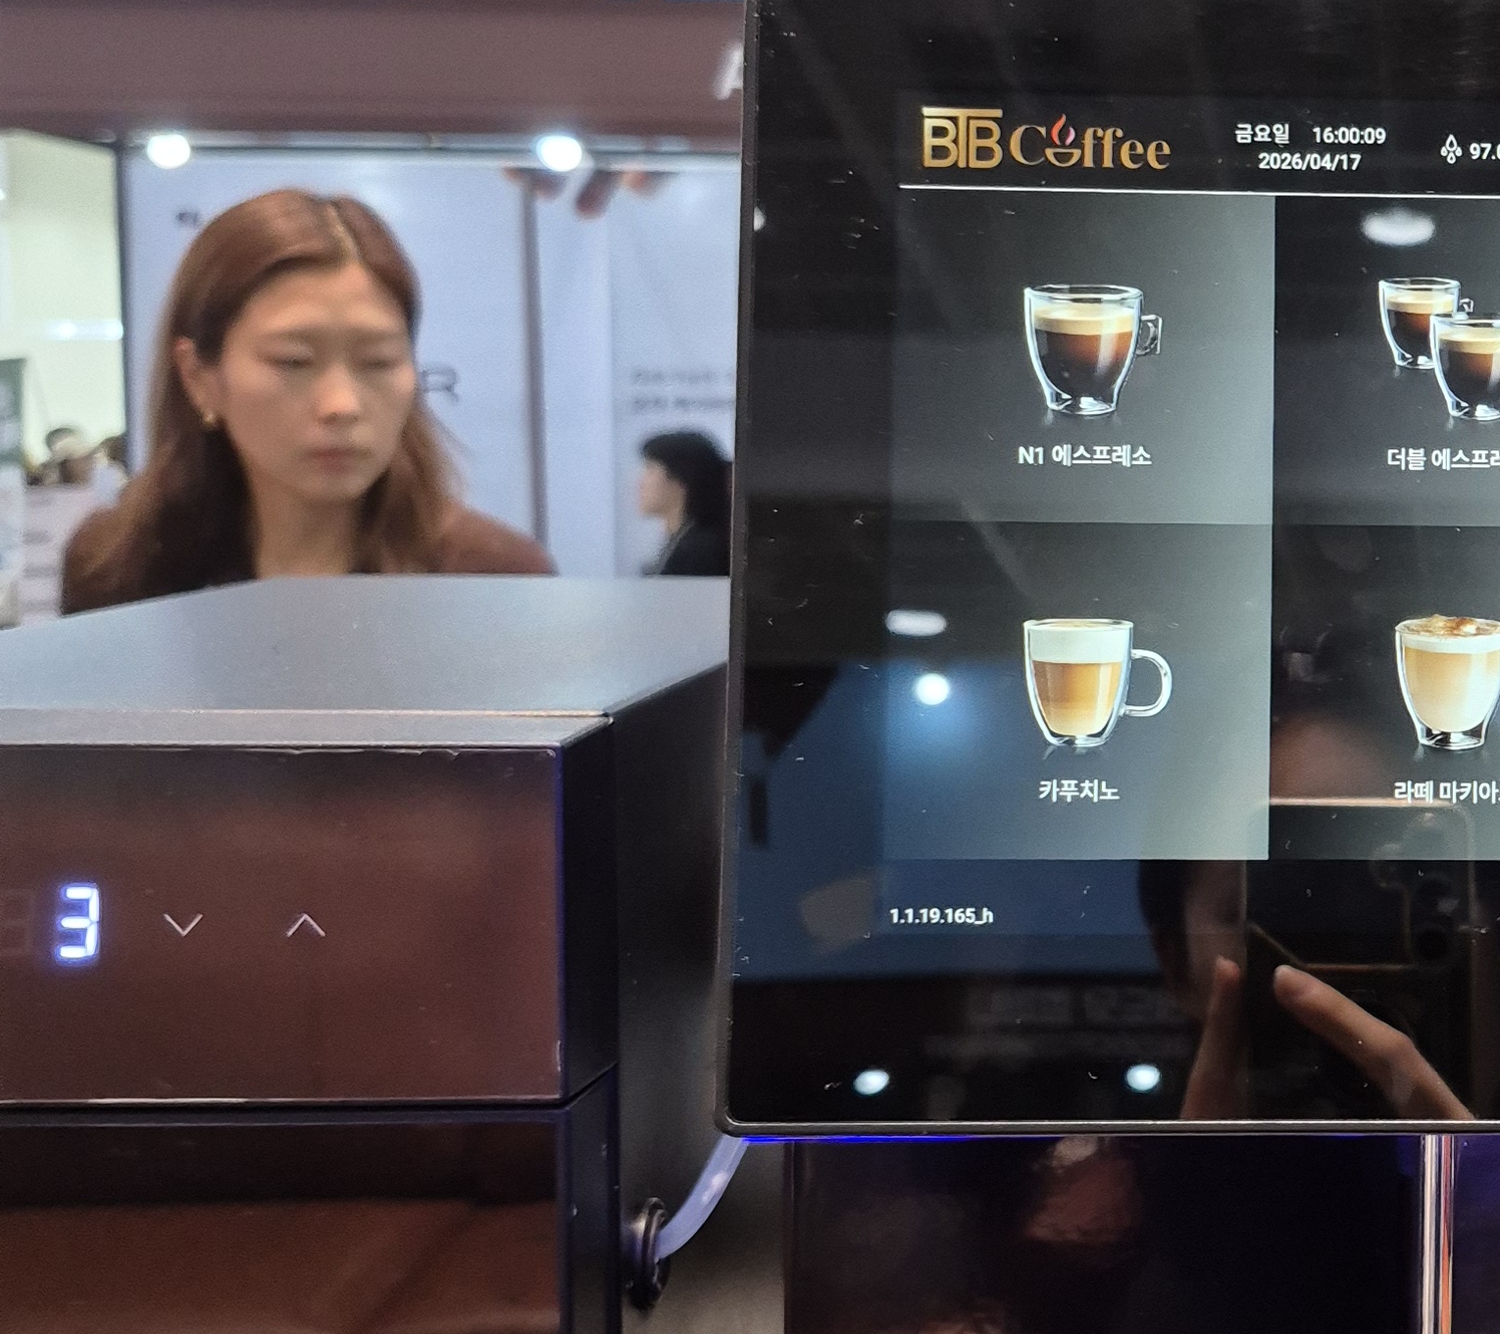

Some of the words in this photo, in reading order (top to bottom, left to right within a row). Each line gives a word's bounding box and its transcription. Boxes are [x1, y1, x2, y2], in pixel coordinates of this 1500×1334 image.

[921, 107, 1003, 168] BTB
[1009, 113, 1172, 170] Coffee
[1235, 123, 1290, 145] 금요일
[1313, 127, 1386, 145] 16:00:09
[1258, 153, 1361, 172] 2026/04/17
[1018, 446, 1044, 465] N1
[1052, 444, 1152, 467] 에스프레소
[1386, 447, 1427, 470] 더블
[1039, 779, 1120, 803] 카푸치노
[1394, 780, 1433, 804] 라떼
[57, 884, 100, 960] 3
[889, 906, 994, 926] 1.1.19.165_h
